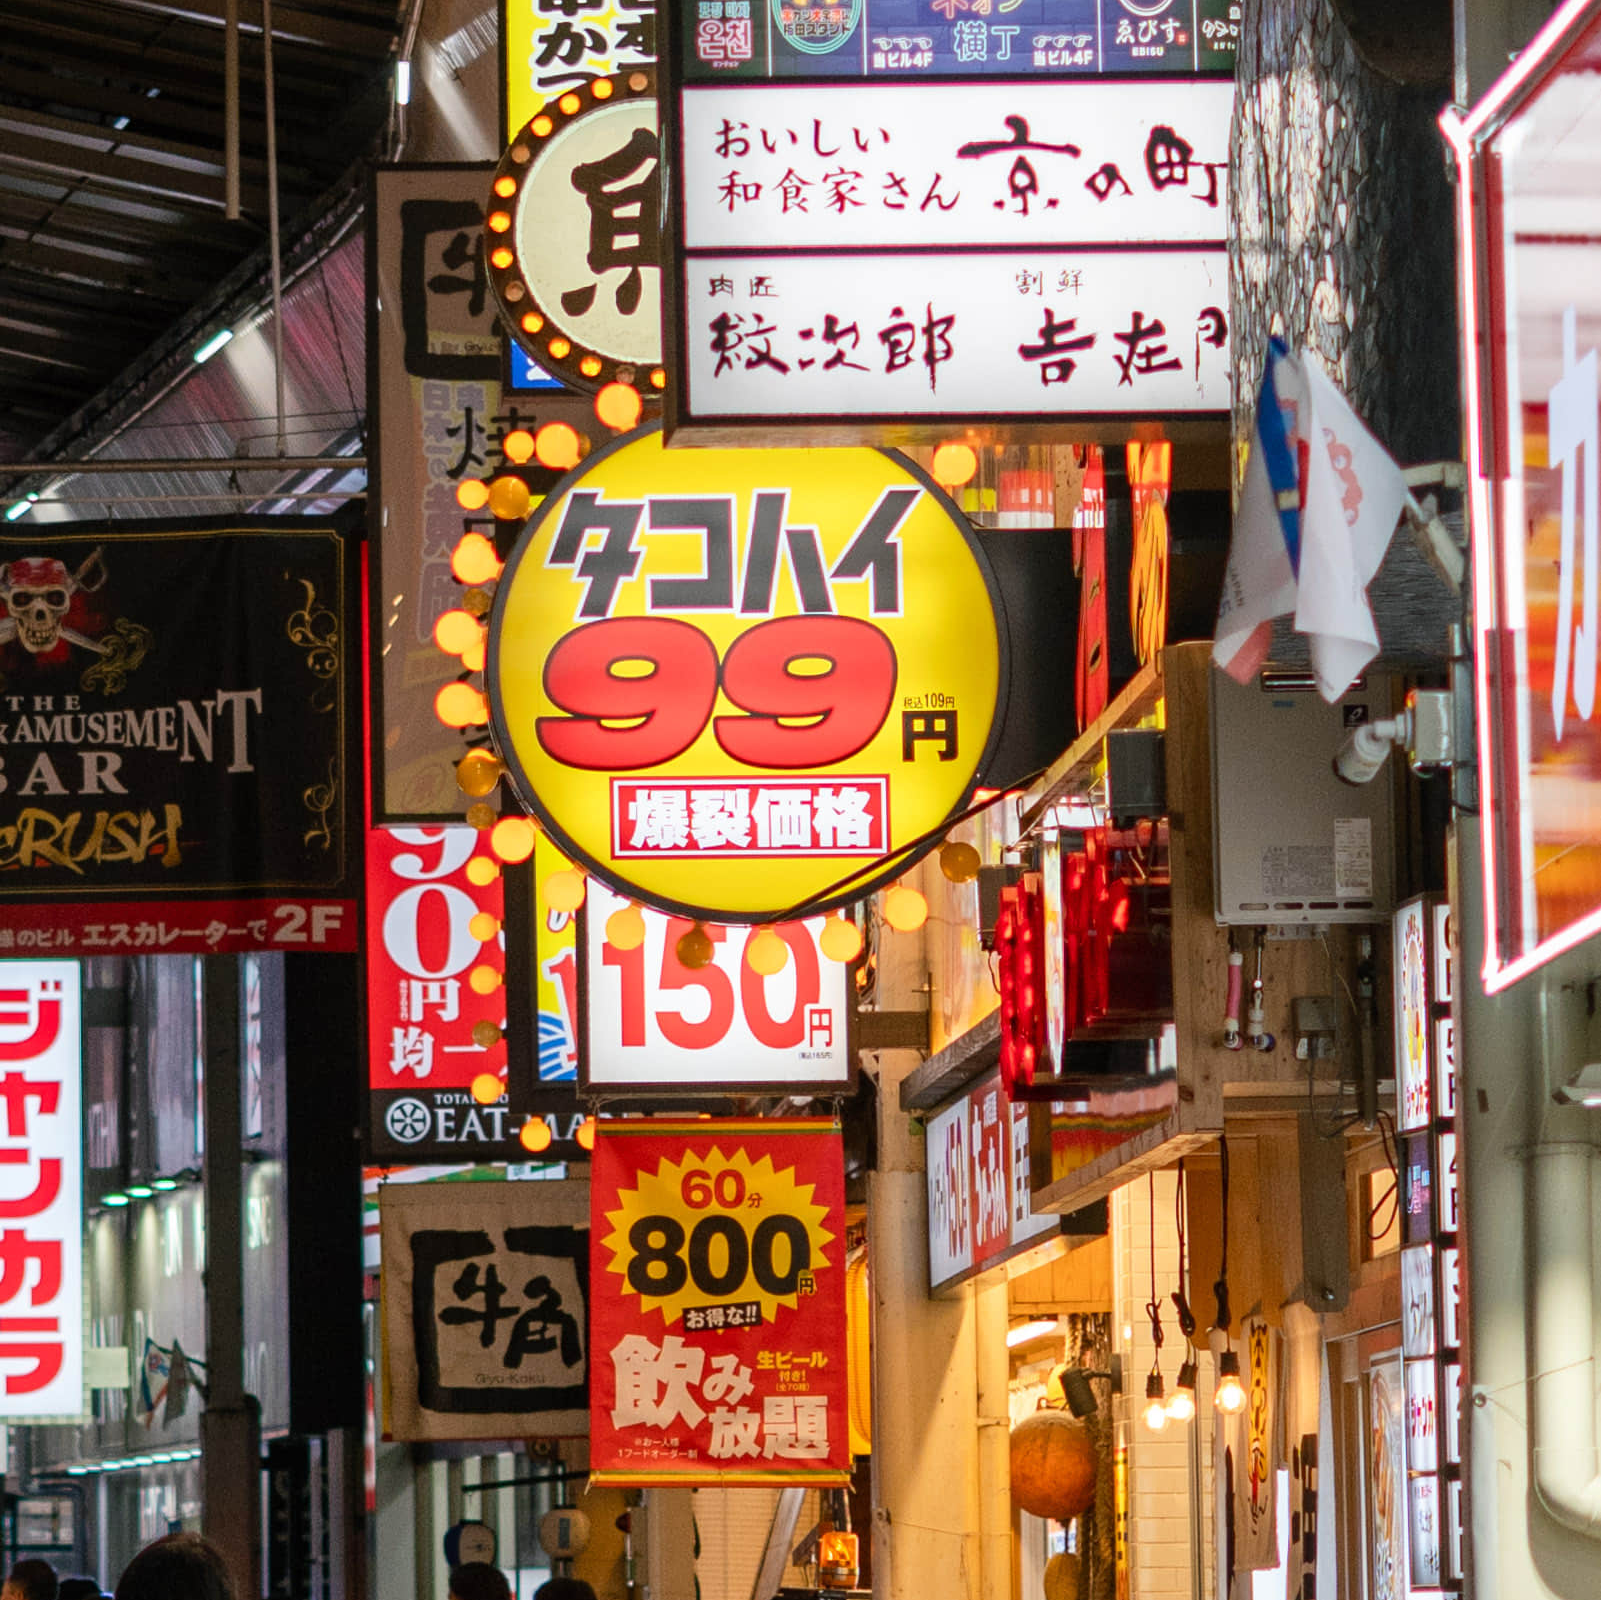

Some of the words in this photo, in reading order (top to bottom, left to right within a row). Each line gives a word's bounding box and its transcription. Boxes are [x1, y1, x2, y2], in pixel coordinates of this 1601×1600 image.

[954, 20, 1020, 61] 横丁
[1116, 18, 1181, 44] ゑびす
[873, 51, 933, 68] 当ビル4F
[1033, 50, 1093, 67] 当ビル4F
[715, 116, 890, 158] おいしい
[717, 167, 961, 216] 和食家さん
[708, 275, 779, 300] 肉匠
[543, 486, 925, 621] タコハイ
[7, 696, 81, 712] THE
[628, 787, 873, 850] 爆裂価格
[680, 1168, 763, 1209] 60分
[438, 1262, 583, 1369] 牛角
[756, 1351, 828, 1370] 生ビール
